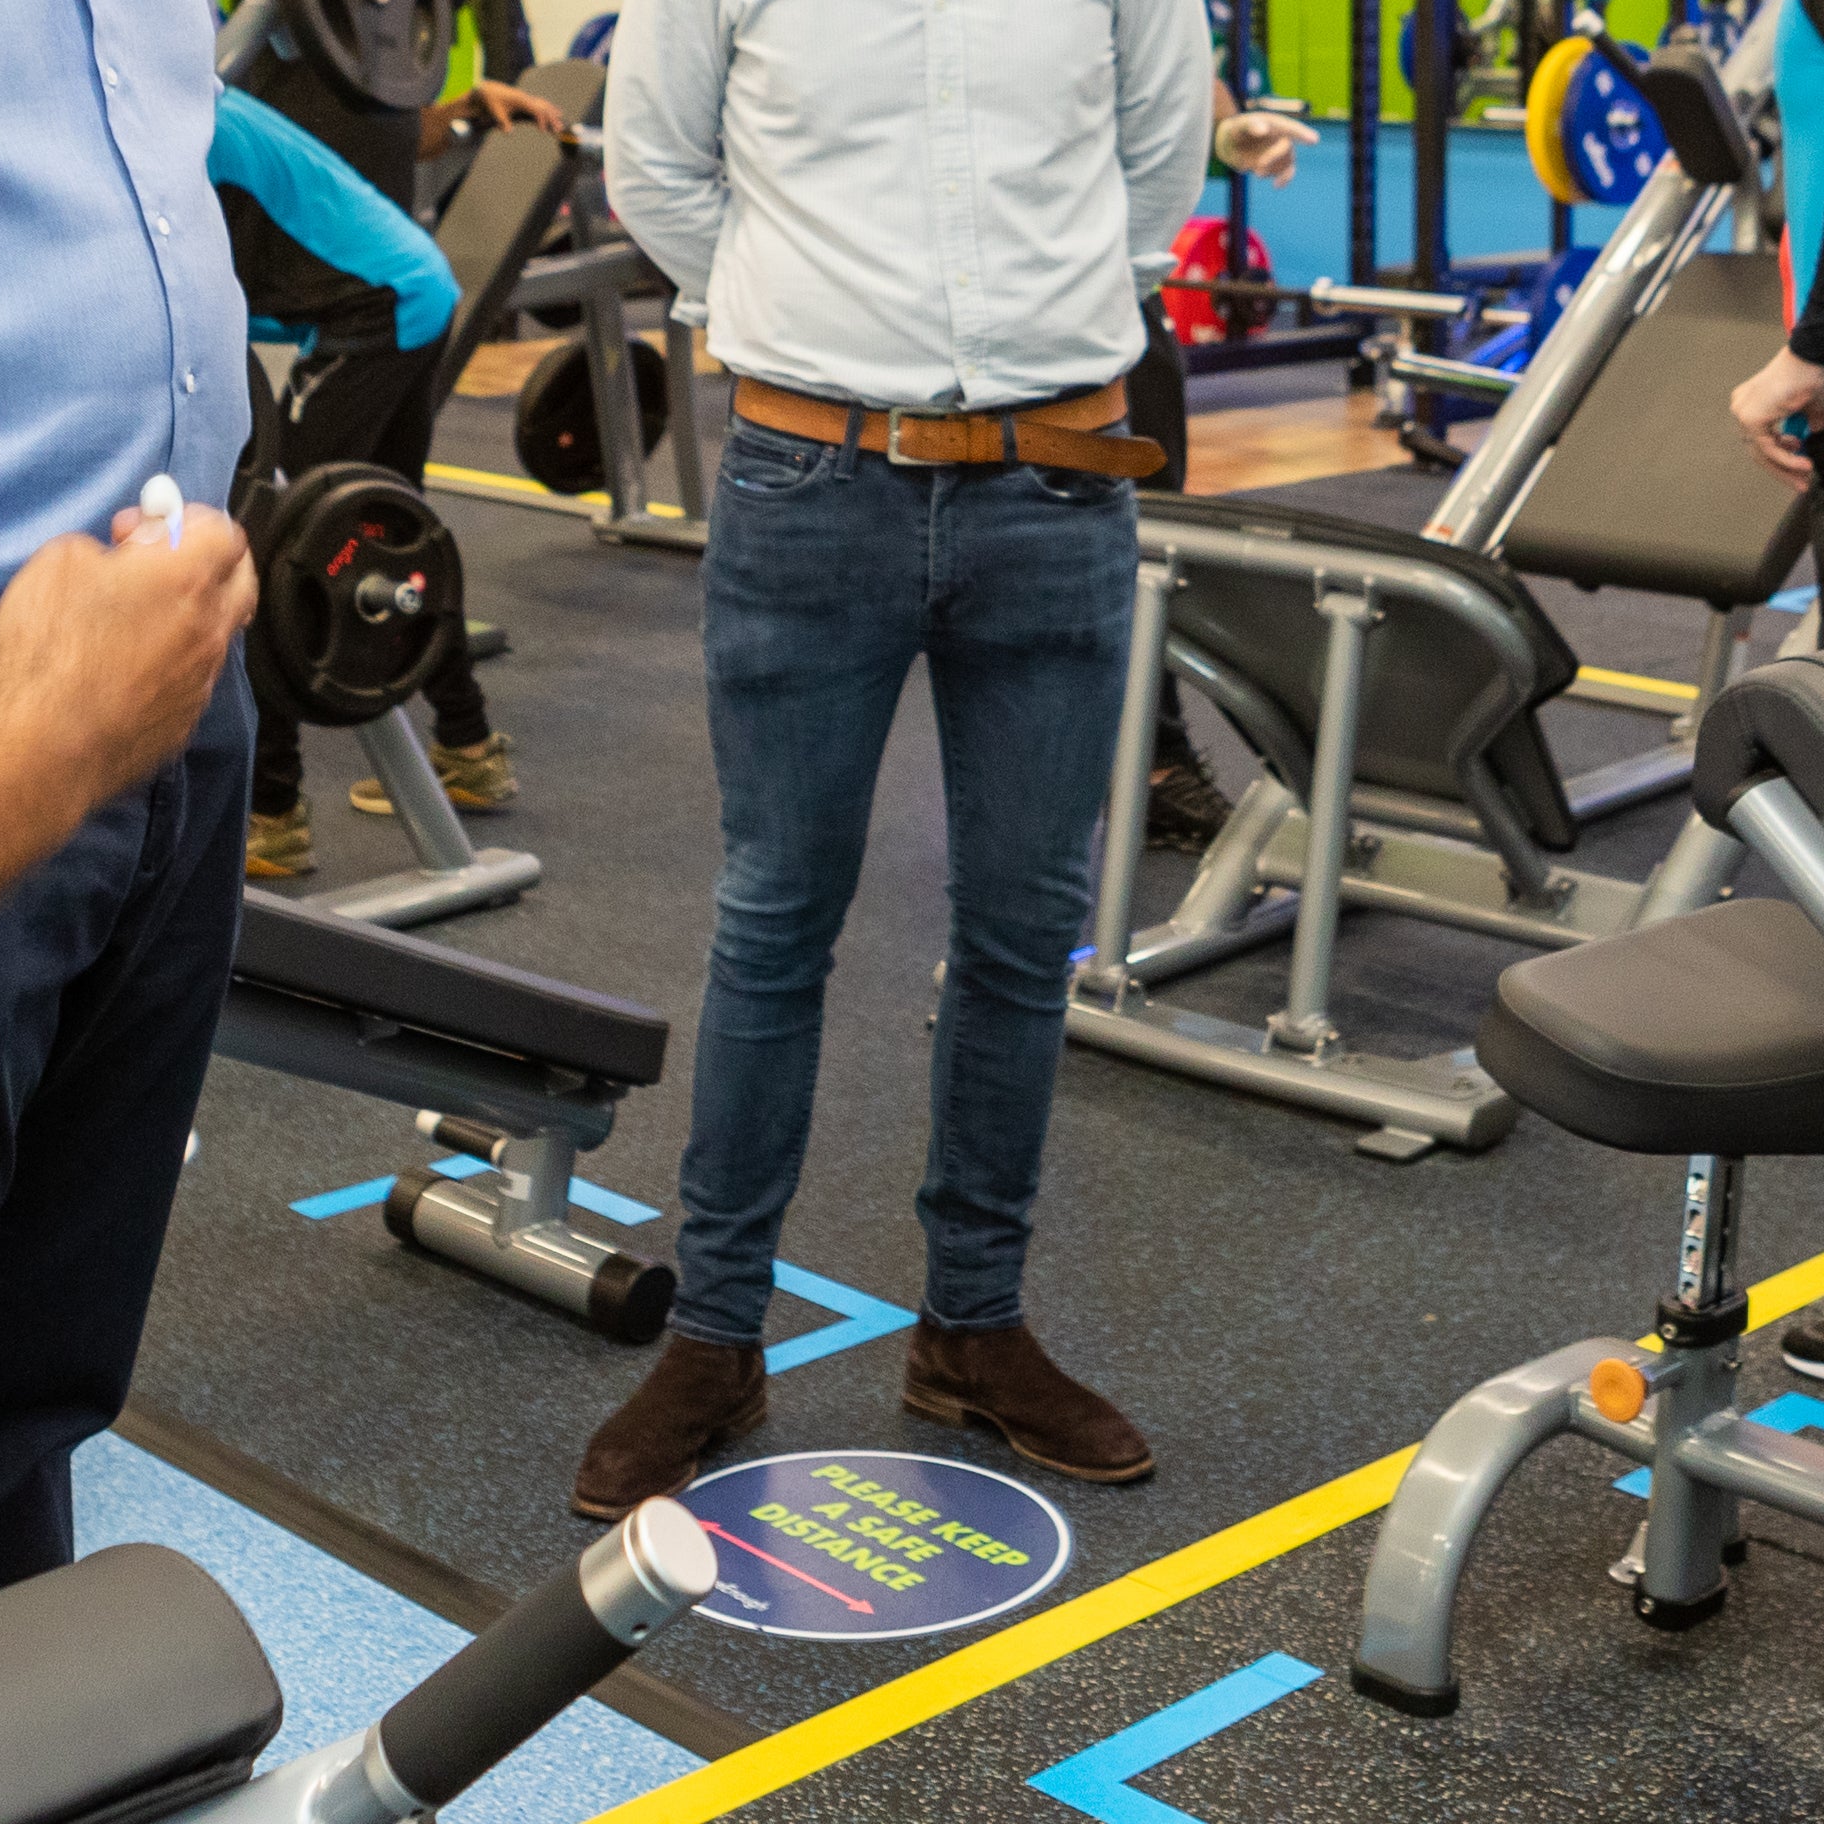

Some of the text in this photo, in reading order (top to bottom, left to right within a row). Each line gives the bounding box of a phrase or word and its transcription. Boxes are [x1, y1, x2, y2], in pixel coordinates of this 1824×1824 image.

[748, 1501, 927, 1592] DISTANCE
[810, 1463, 1030, 1567] PLEASE KEEP
[811, 1501, 944, 1564] A SAFE
